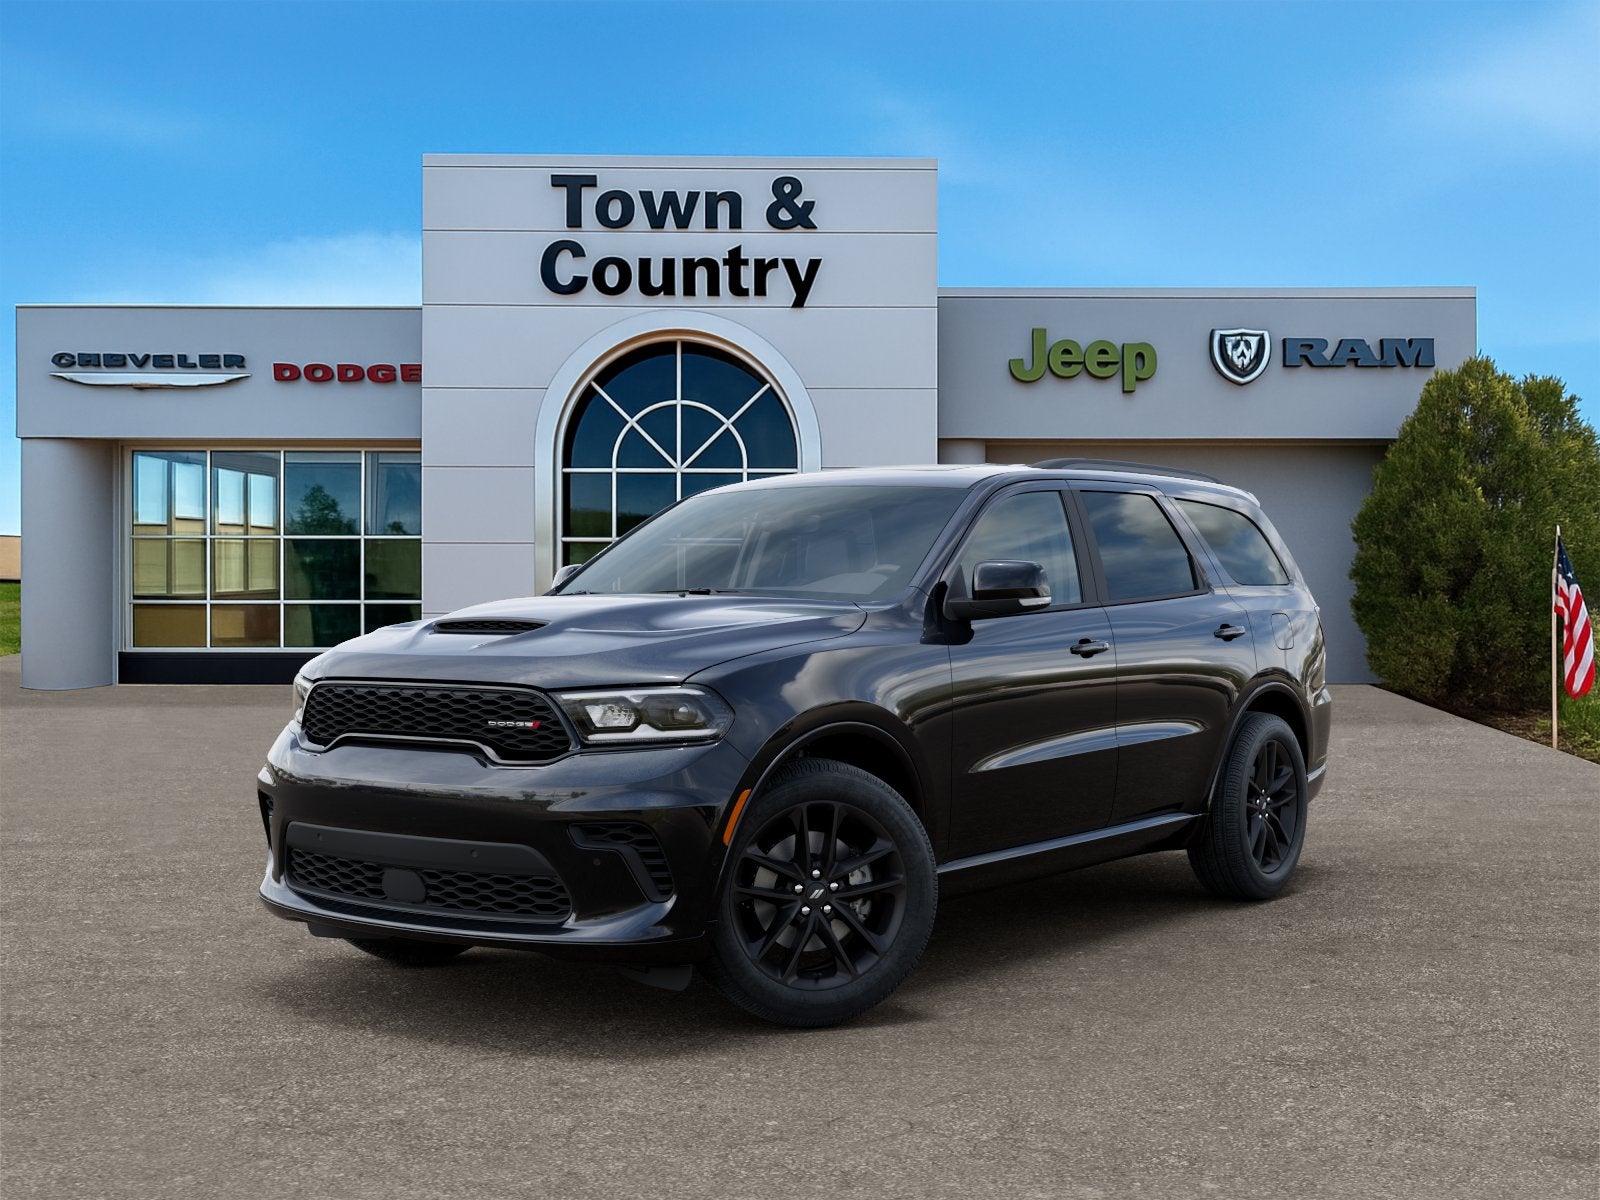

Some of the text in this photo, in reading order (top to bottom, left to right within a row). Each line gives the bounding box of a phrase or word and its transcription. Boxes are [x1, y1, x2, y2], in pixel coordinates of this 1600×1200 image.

[551, 174, 818, 229] Town &
[540, 239, 822, 308] Country
[272, 363, 422, 383] DODGE
[1009, 328, 1158, 393] Jeep
[1282, 337, 1435, 368] RAM
[487, 720, 534, 728] DODGE
